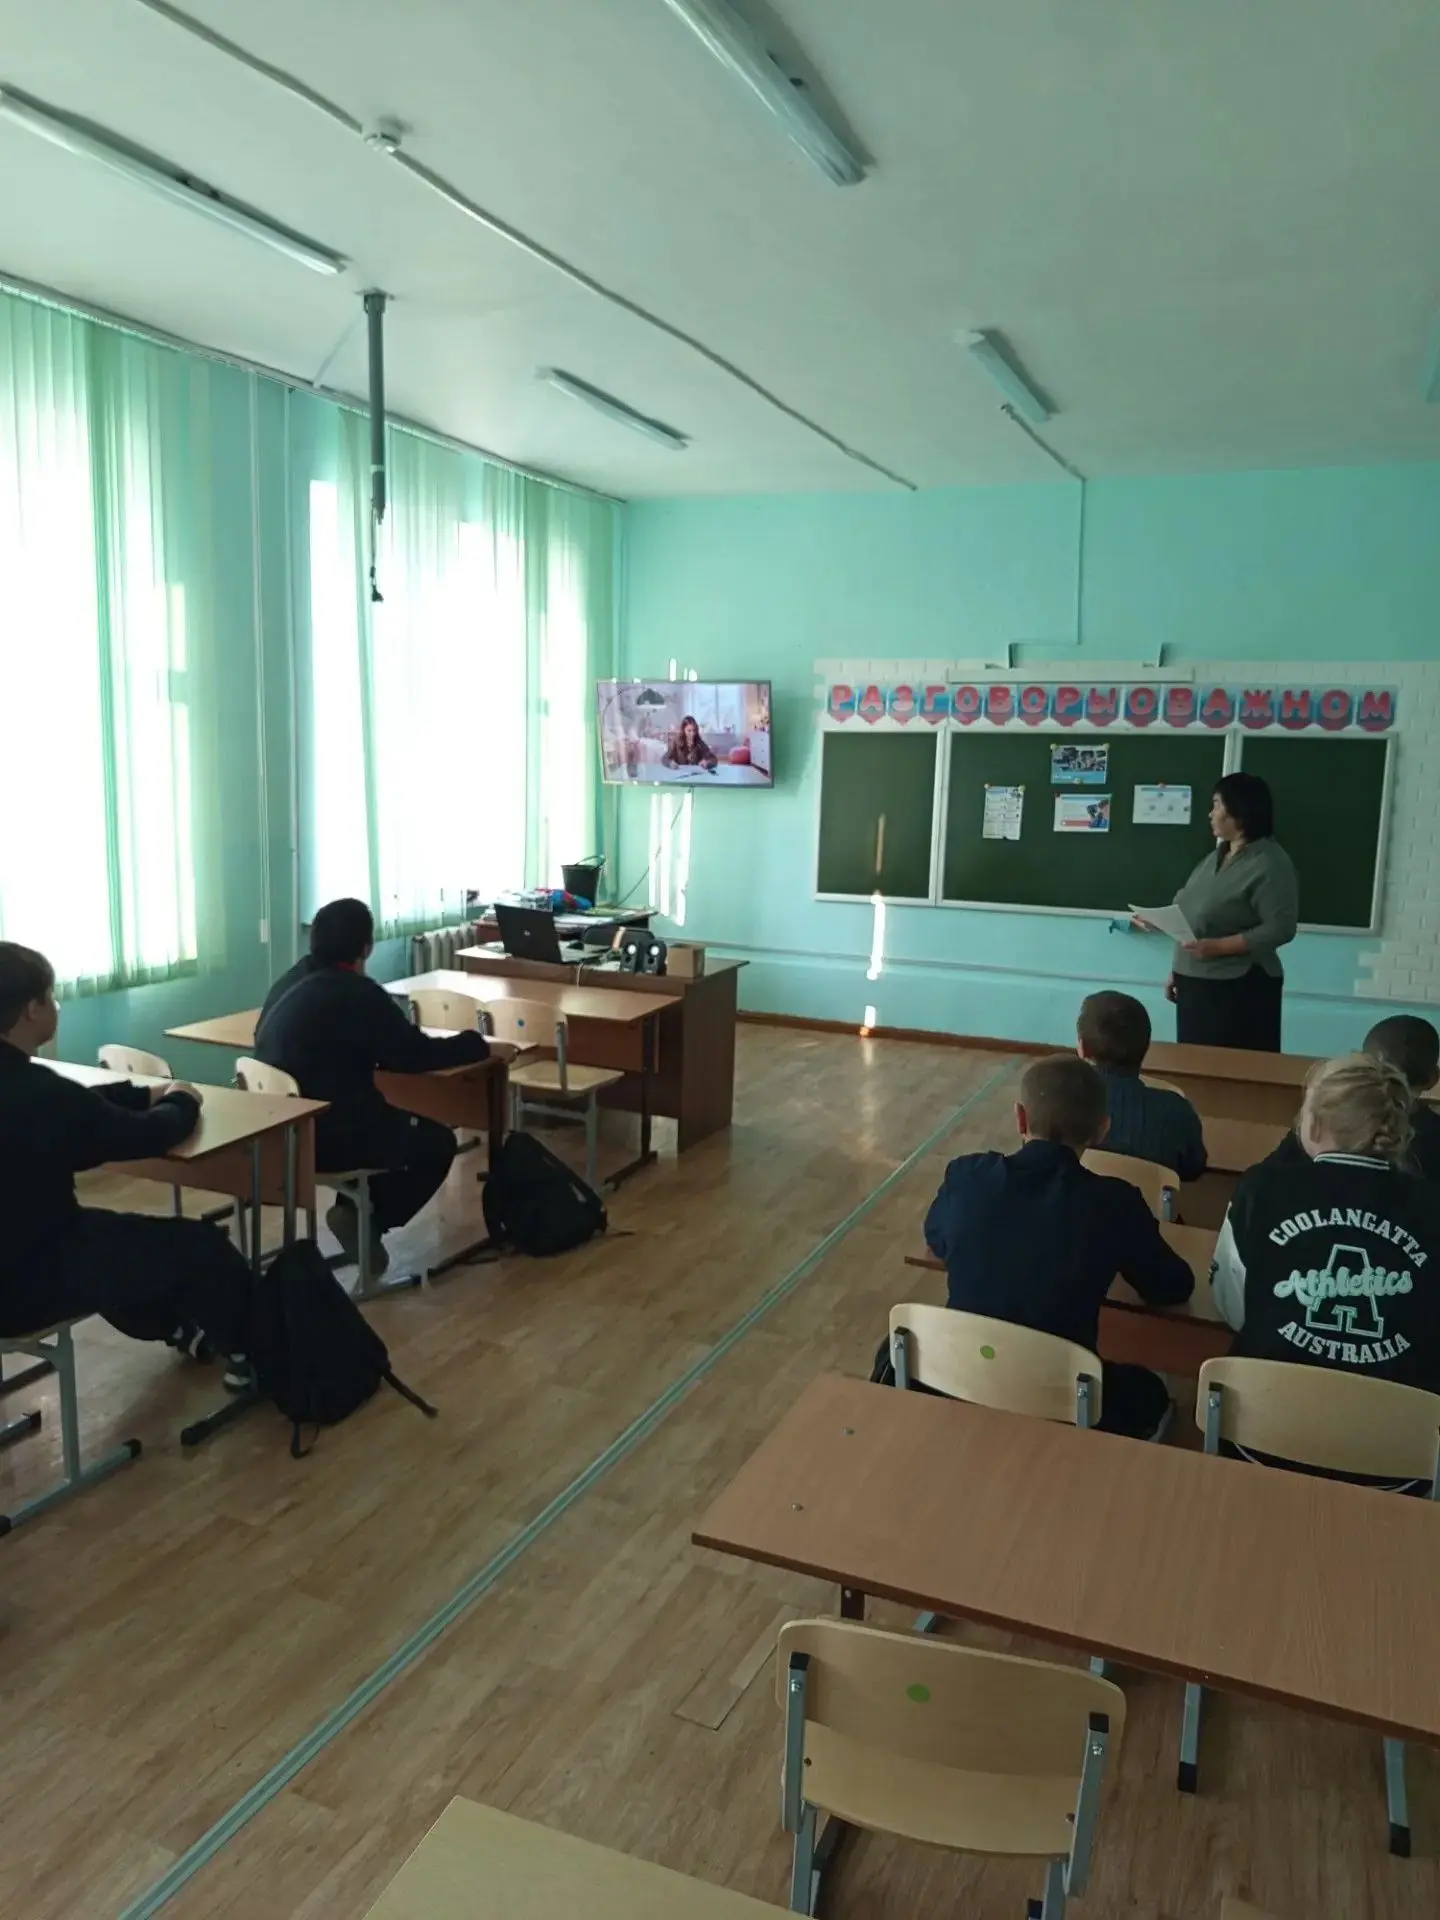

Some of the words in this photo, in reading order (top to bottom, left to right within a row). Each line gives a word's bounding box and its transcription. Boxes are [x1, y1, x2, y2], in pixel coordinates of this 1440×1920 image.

[1268, 1207, 1429, 1268] COOLANGATTA
[1273, 1266, 1413, 1307] Athletics
[1277, 1320, 1411, 1364] AUSTRALIA
